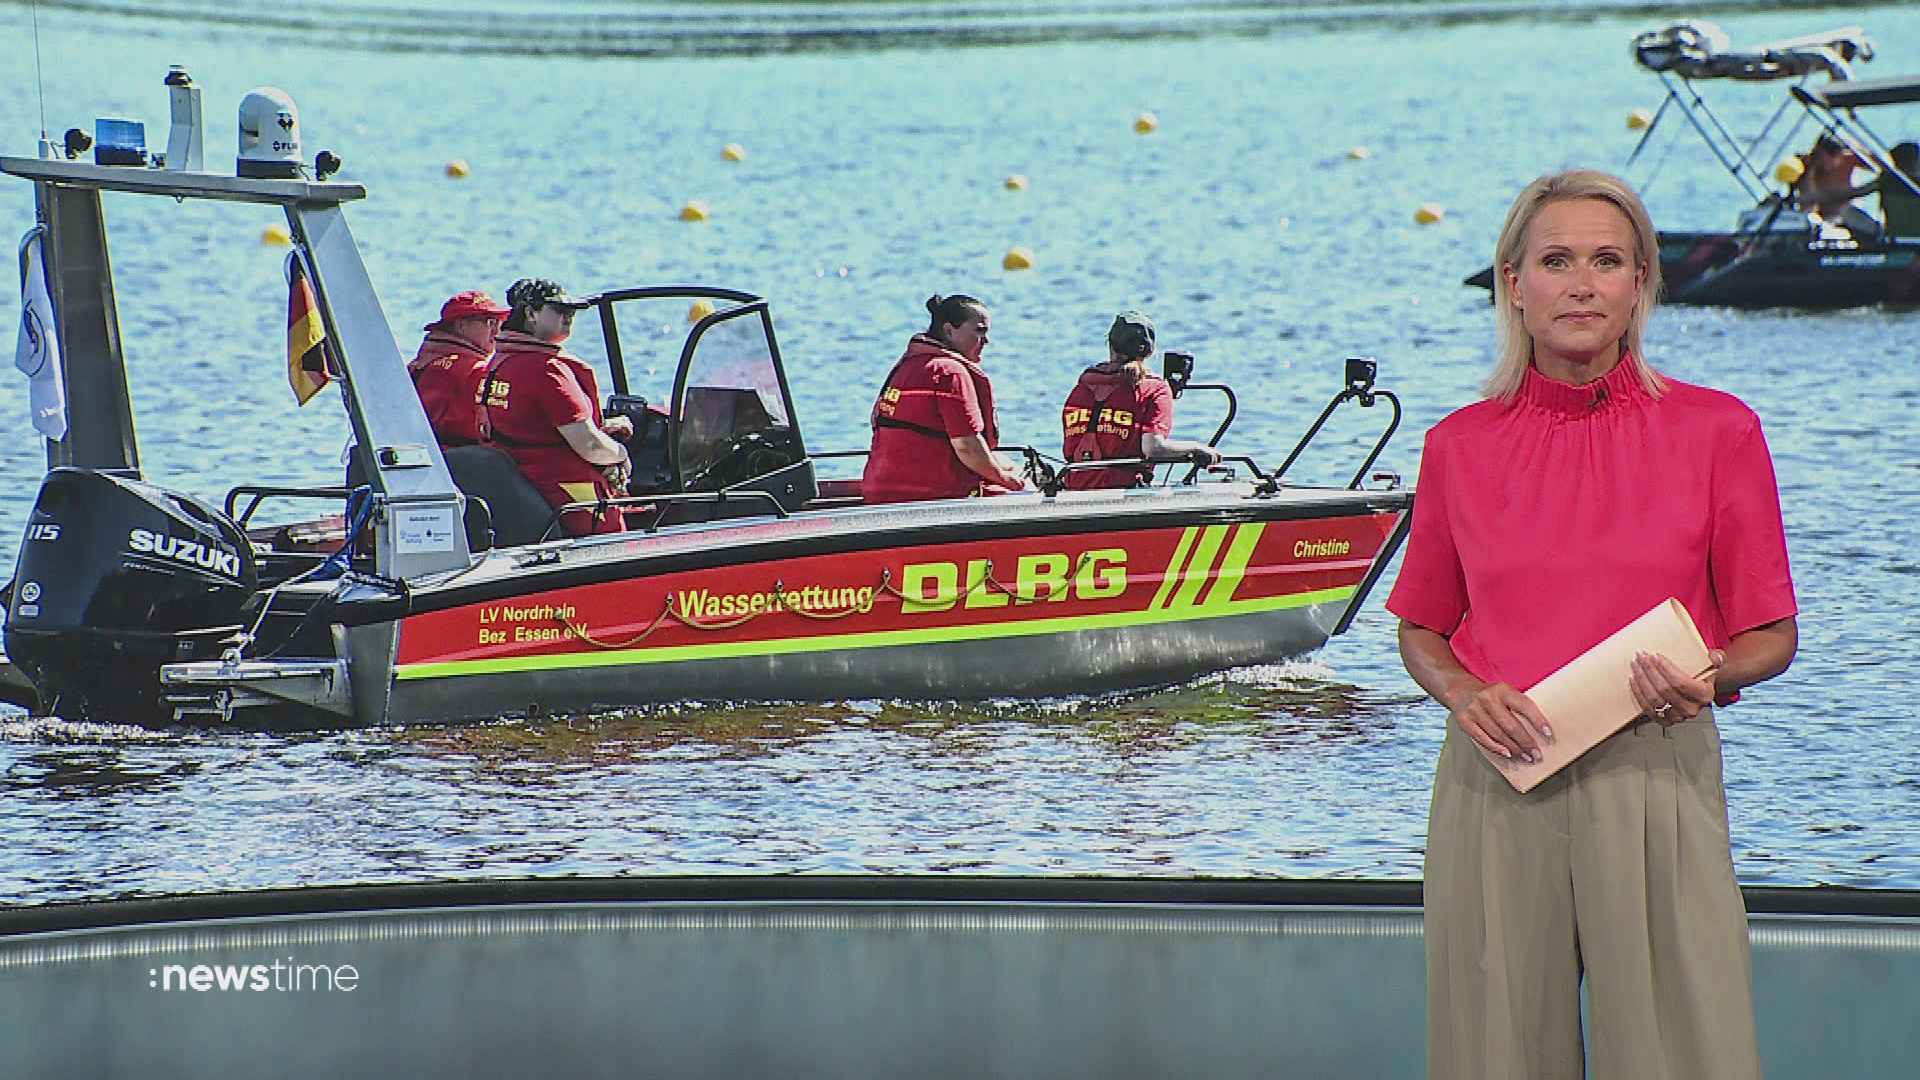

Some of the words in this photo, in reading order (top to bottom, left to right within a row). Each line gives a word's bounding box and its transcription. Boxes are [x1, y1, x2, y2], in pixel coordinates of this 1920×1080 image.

[27, 524, 61, 541] 115
[129, 528, 241, 578] SUZUKI
[1293, 538, 1351, 559] Christine
[901, 548, 1128, 614] DLRG
[479, 606, 500, 624] LV
[479, 628, 507, 644] Bez
[514, 626, 560, 642] Essen
